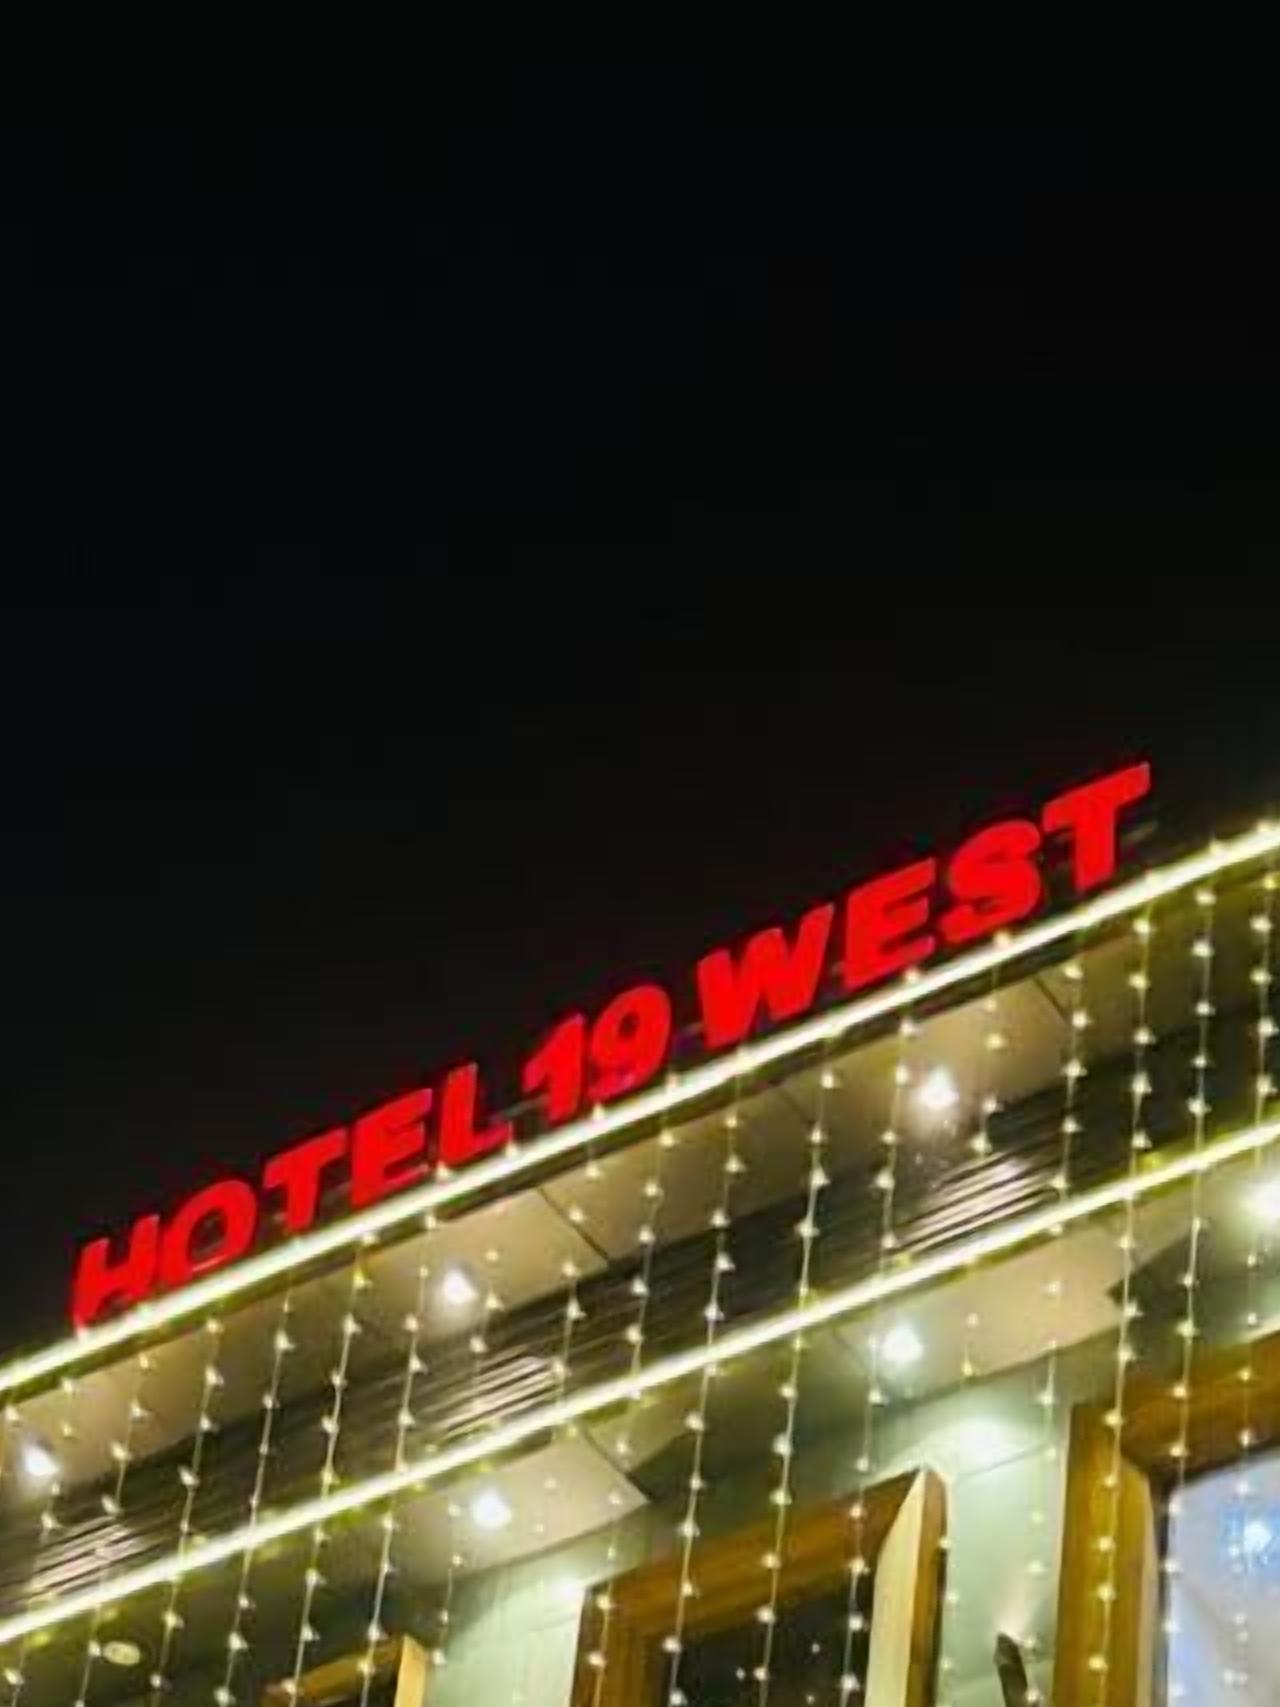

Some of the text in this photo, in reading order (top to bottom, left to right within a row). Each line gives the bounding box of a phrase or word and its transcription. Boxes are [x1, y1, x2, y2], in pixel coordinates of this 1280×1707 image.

[66, 761, 1151, 1334] HOTEL 19 WEST
